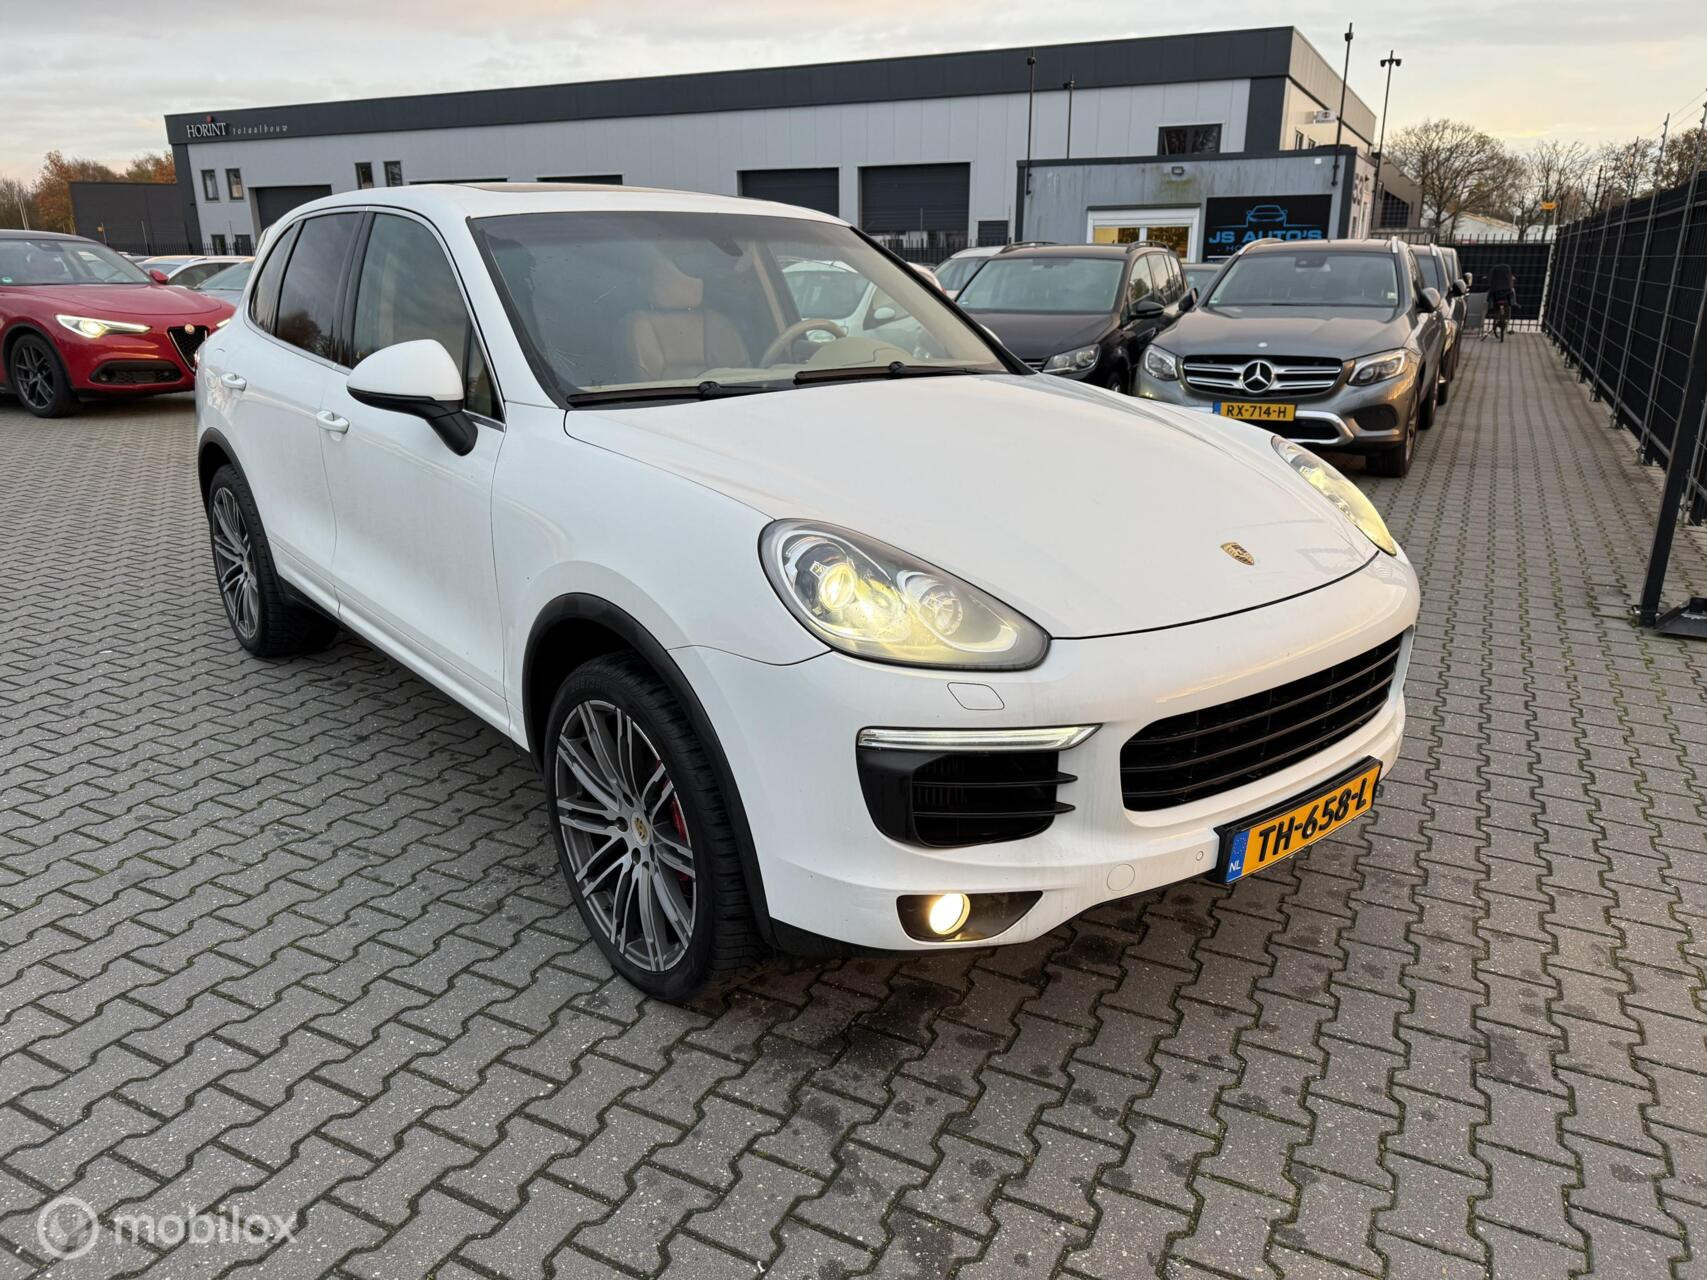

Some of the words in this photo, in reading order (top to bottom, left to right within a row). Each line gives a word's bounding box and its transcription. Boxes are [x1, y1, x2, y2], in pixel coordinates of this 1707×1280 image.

[186, 122, 226, 138] HORINT
[1208, 231, 1236, 243] JS
[1243, 229, 1323, 243] AUTO'S
[1226, 404, 1287, 418] RX-714-H
[1258, 777, 1368, 863] TH-658-L
[1229, 860, 1241, 873] NL
